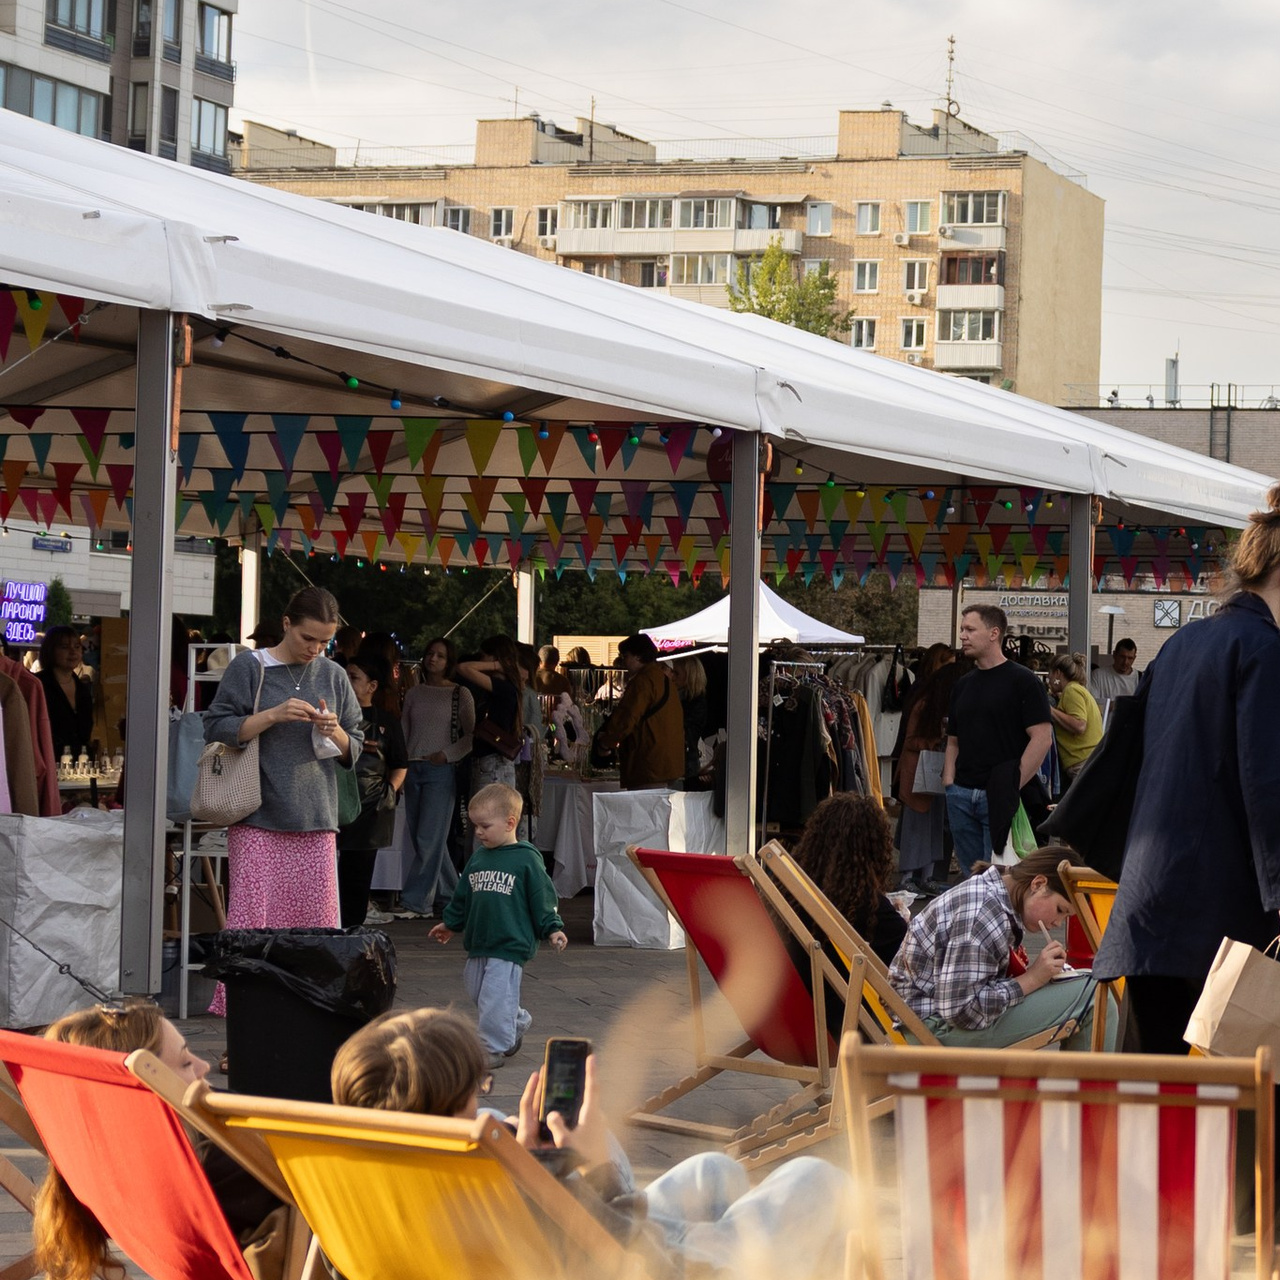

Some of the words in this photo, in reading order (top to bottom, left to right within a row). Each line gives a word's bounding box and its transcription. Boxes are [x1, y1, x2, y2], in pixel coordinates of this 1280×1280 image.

[999, 595, 1068, 607] ДОСТАВКА
[468, 870, 516, 886] BROOKLYN
[483, 882, 513, 895] LEAGUE
